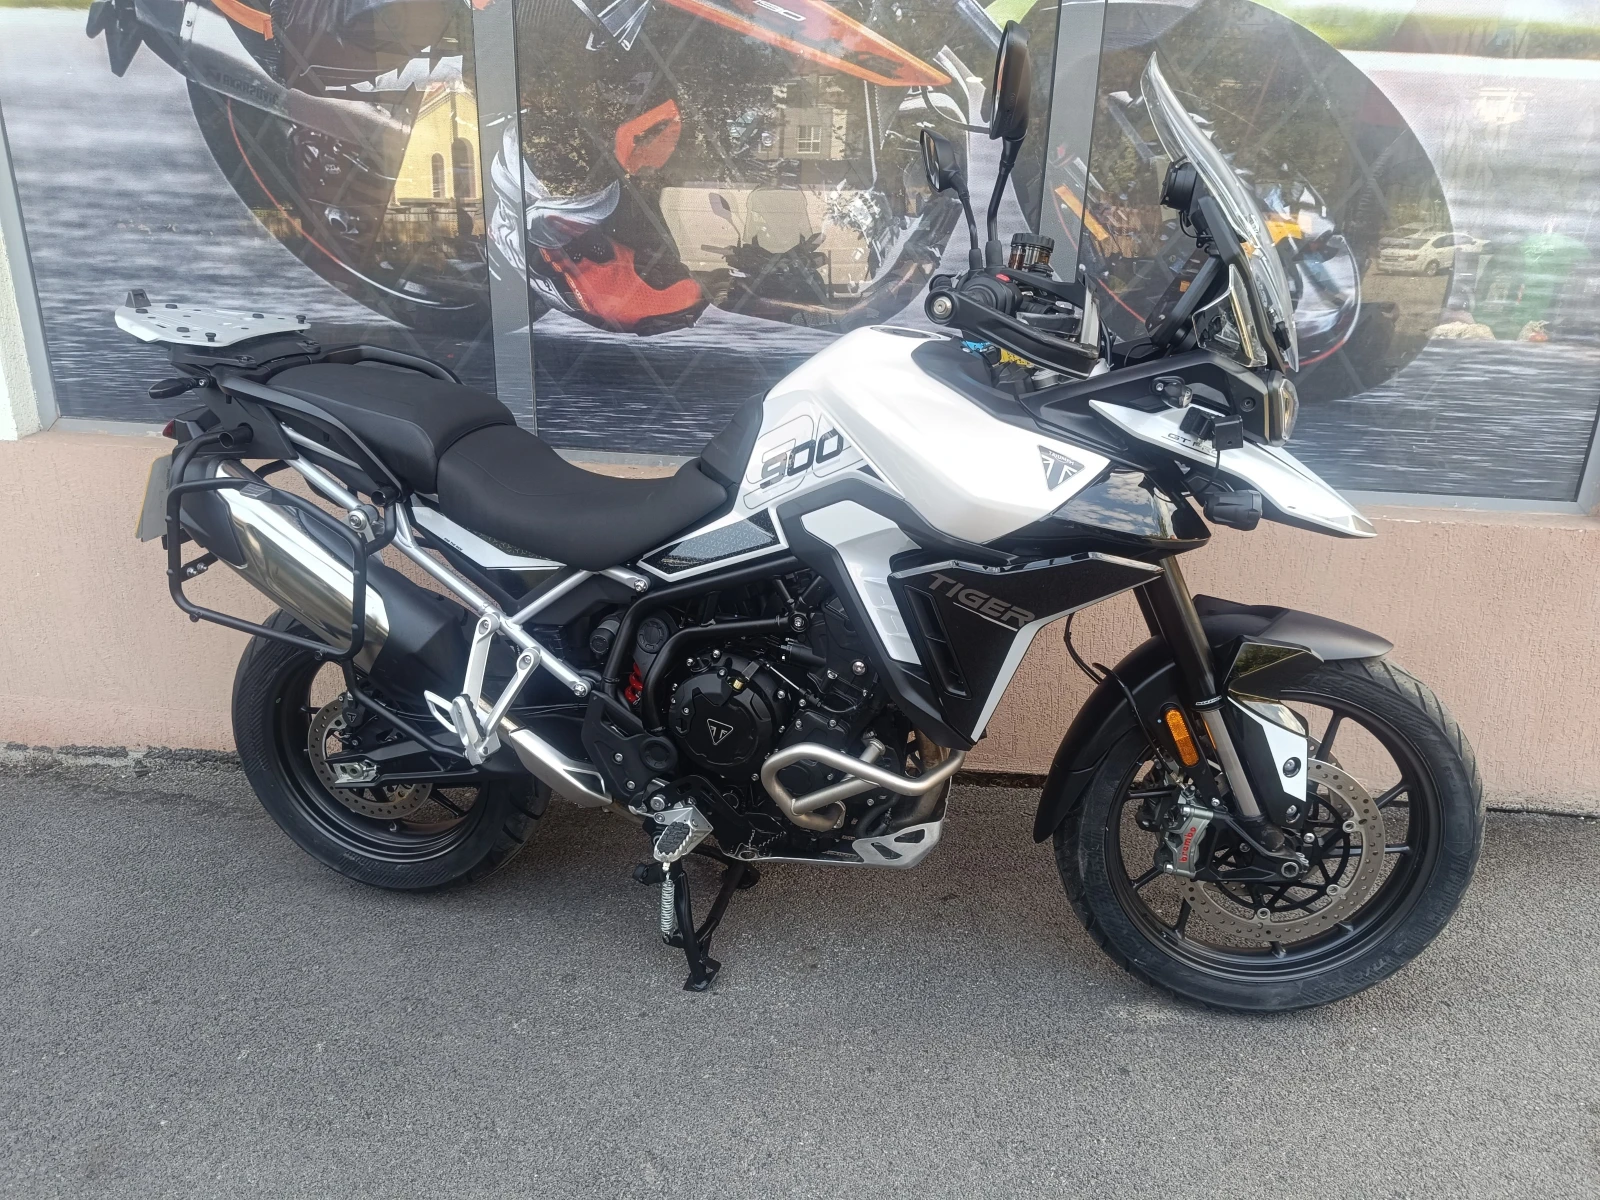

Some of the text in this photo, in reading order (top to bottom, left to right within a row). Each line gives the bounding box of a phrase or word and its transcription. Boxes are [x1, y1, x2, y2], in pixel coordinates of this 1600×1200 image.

[760, 427, 844, 490] 900
[1167, 433, 1191, 443] GT
[928, 572, 1036, 628] TIGER
[1178, 826, 1197, 863] brembo
